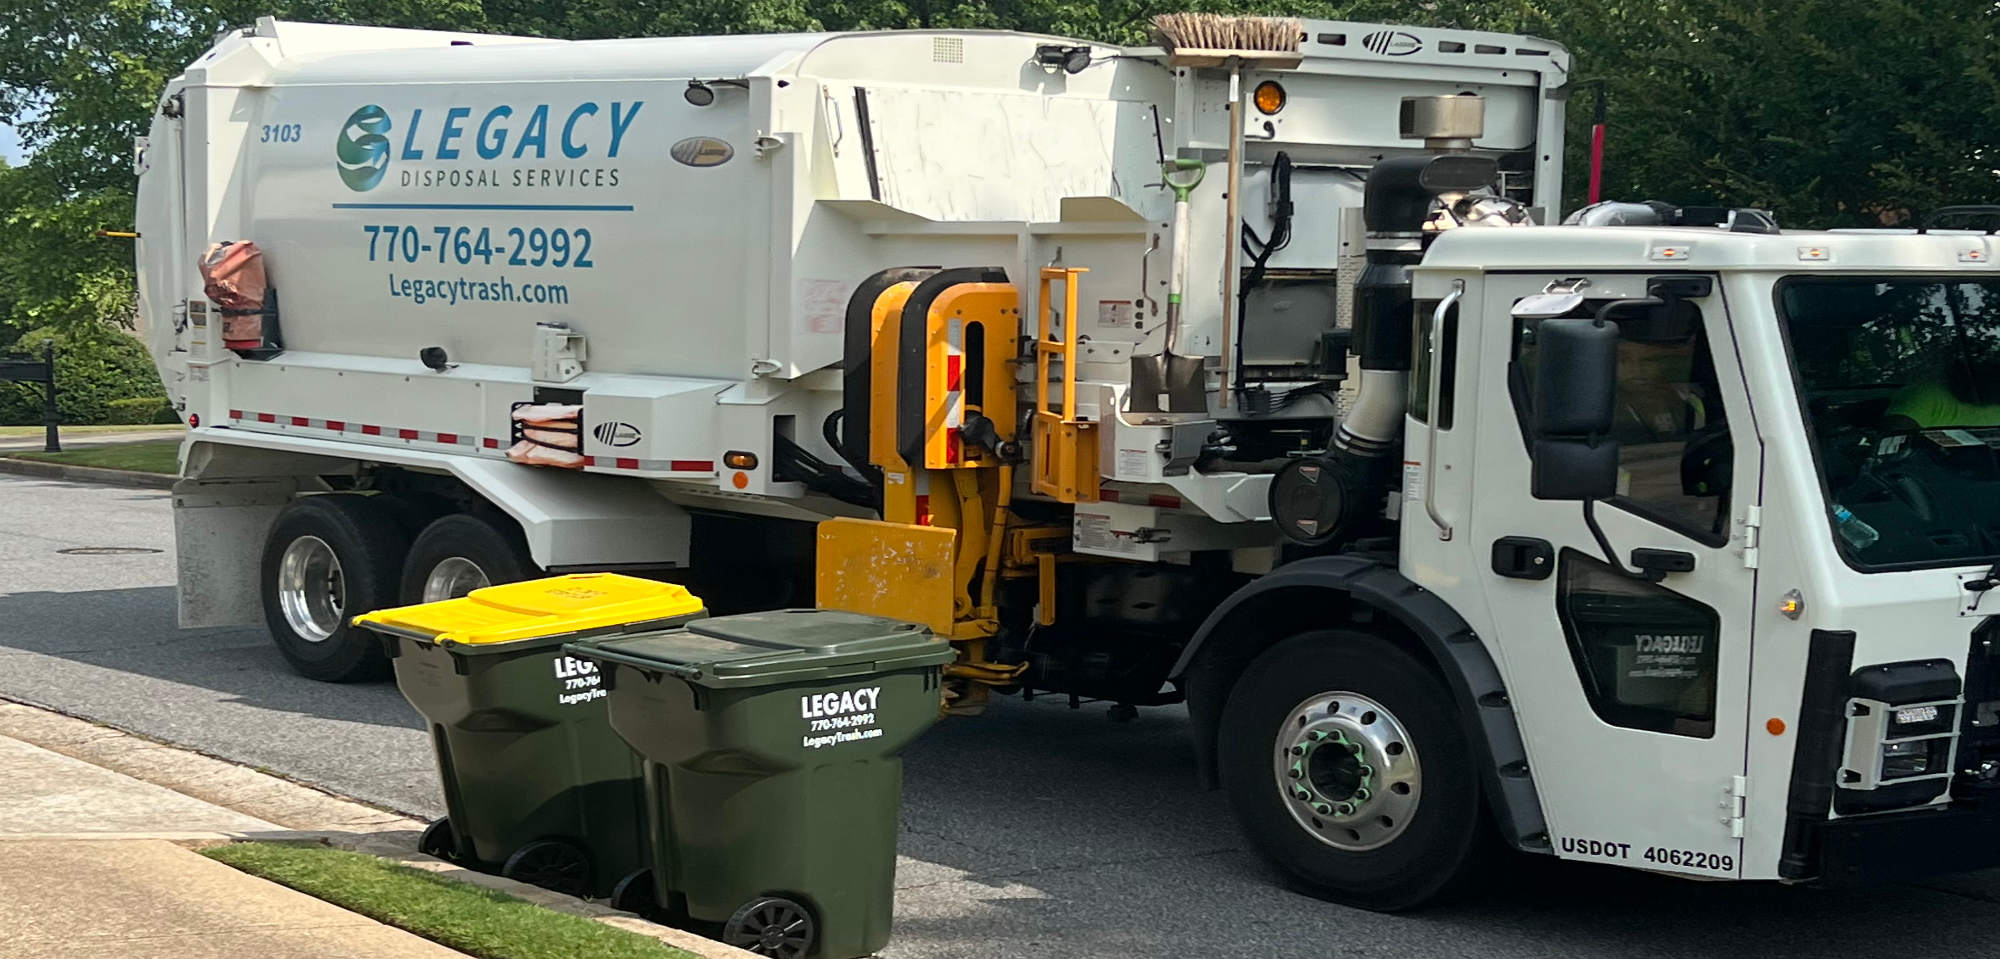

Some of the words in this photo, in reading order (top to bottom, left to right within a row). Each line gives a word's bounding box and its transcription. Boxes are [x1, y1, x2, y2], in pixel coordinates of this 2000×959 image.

[261, 123, 301, 143] 3103
[401, 101, 643, 160] LEGACY
[401, 169, 500, 188] DISPOSAL
[512, 168, 620, 187] SERVICES
[363, 225, 594, 268] 770-764-2992
[389, 273, 569, 305] Legacytrash.com
[554, 656, 599, 678] LEG
[801, 686, 881, 718] LEGACY
[811, 713, 875, 732] 770-764-2992
[803, 728, 883, 748] LegacyTrash.com
[1561, 837, 1631, 859] USDOT
[1643, 846, 1734, 871] 4062209
